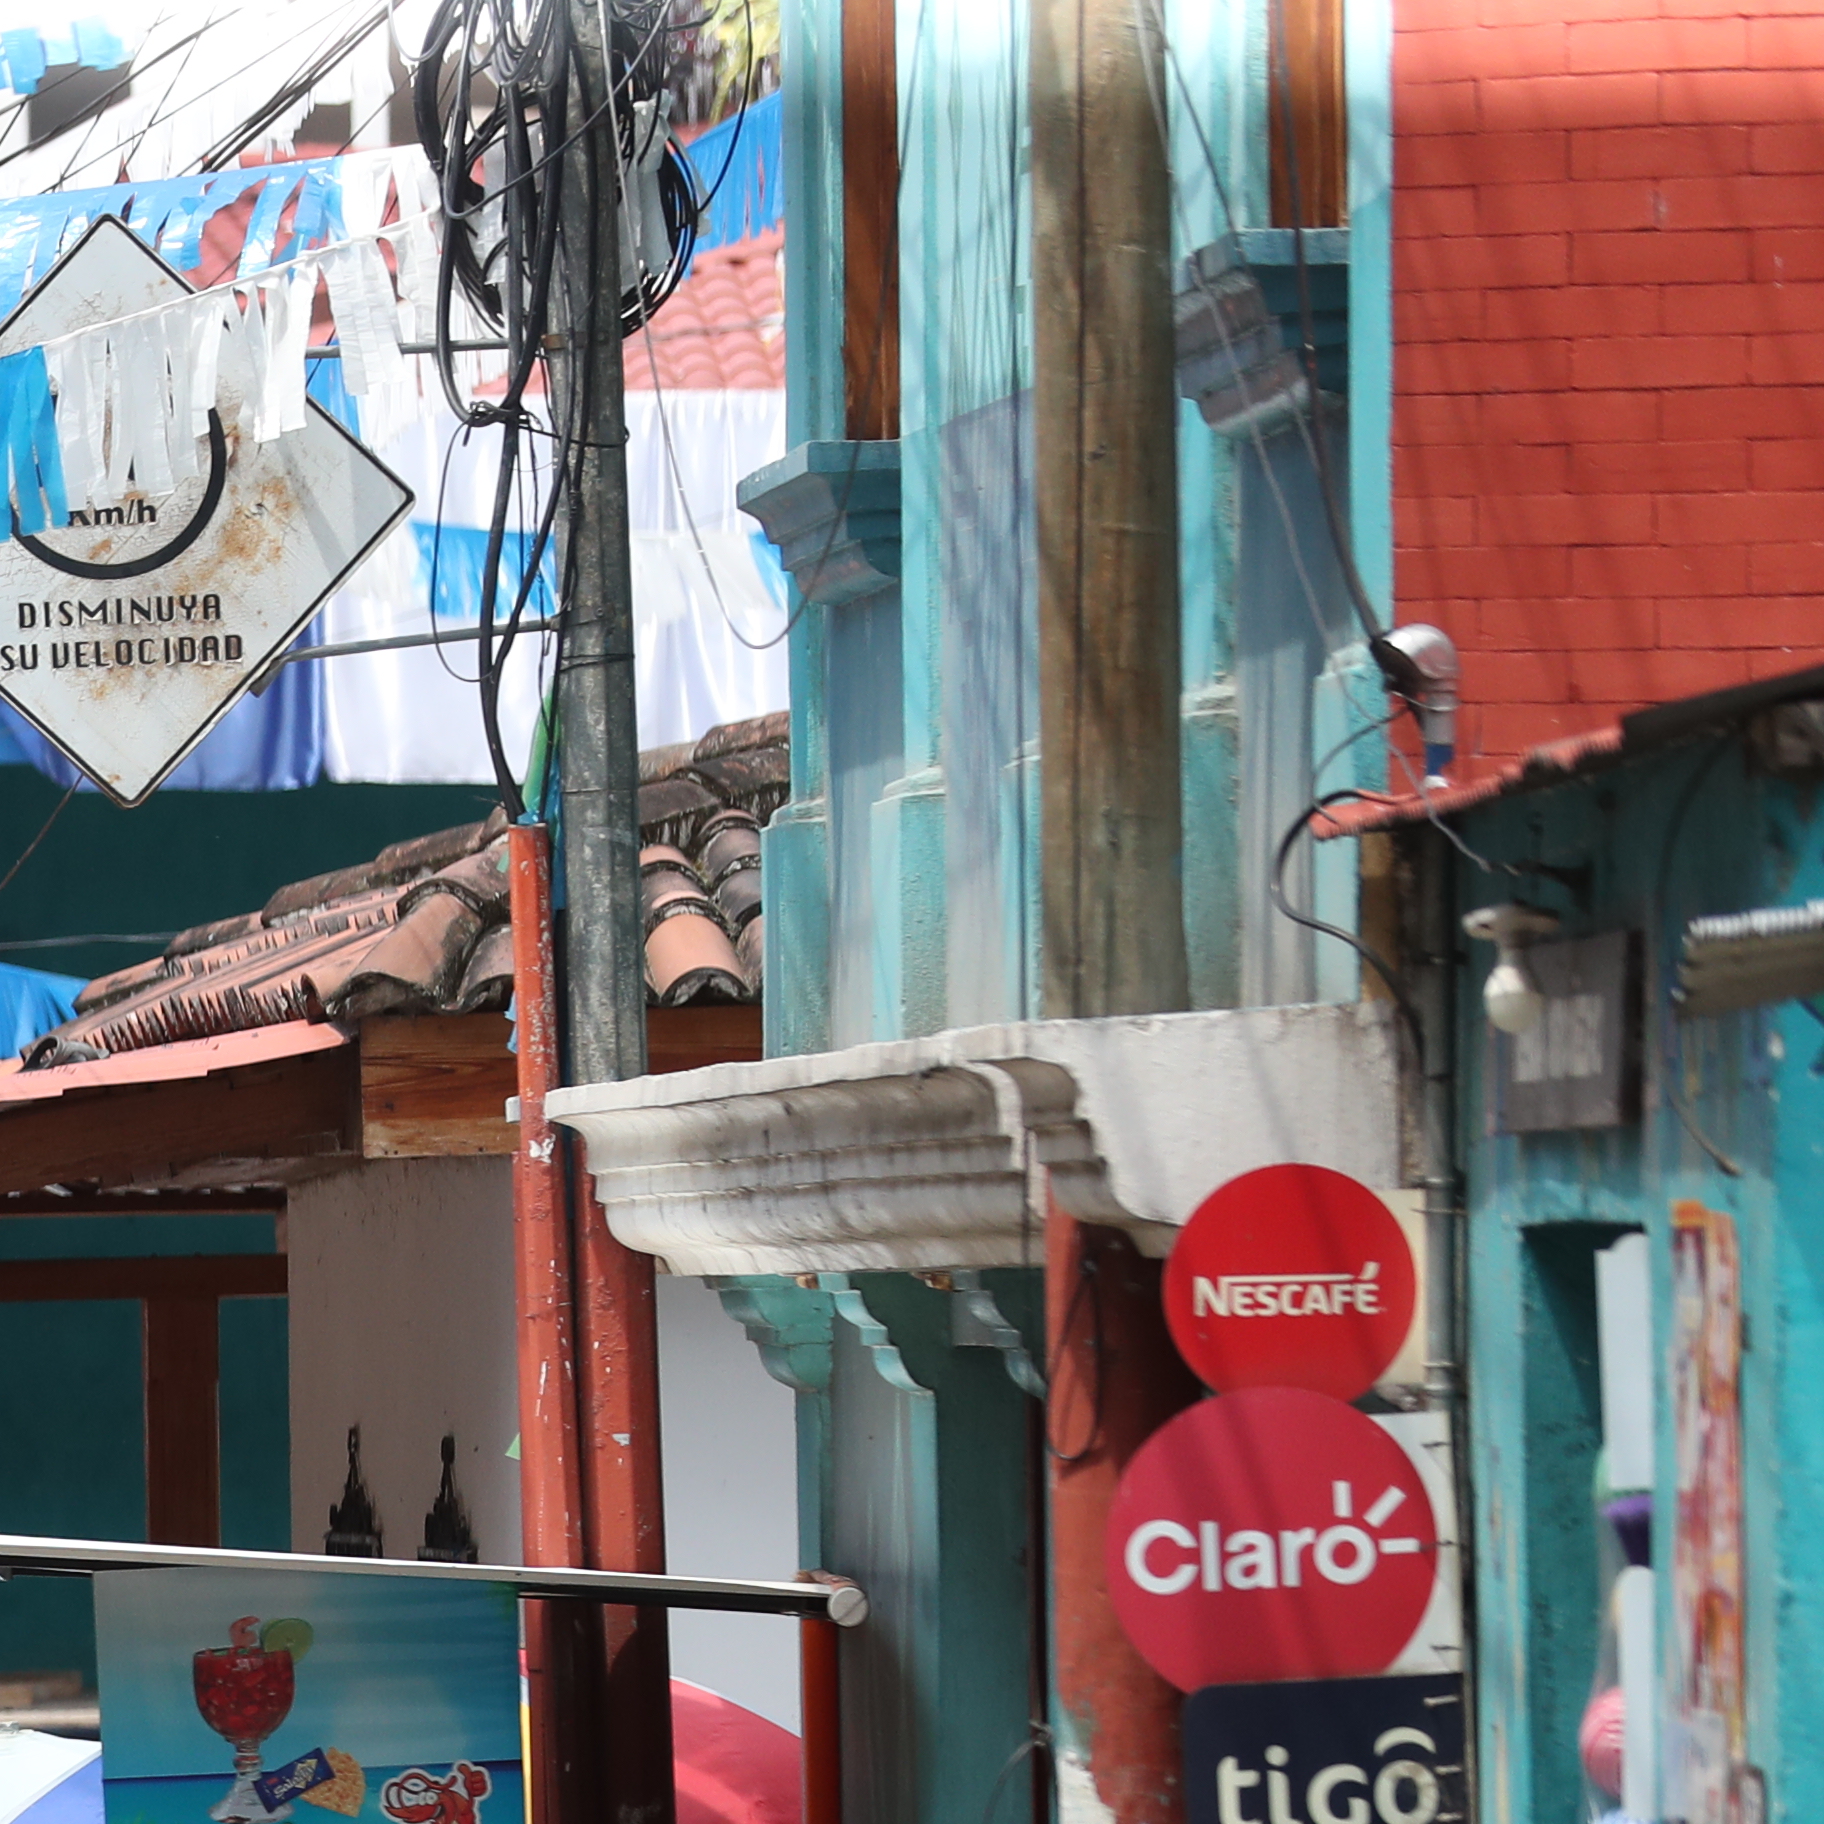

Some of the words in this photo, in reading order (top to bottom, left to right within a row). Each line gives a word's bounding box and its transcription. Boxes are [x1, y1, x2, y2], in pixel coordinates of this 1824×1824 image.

[18, 592, 222, 630] DISMINUYA
[0, 643, 38, 671] SU
[52, 633, 243, 669] VELOCIDAD
[1193, 1262, 1380, 1317] NESCAFÉ
[1124, 1518, 1378, 1595] Claro
